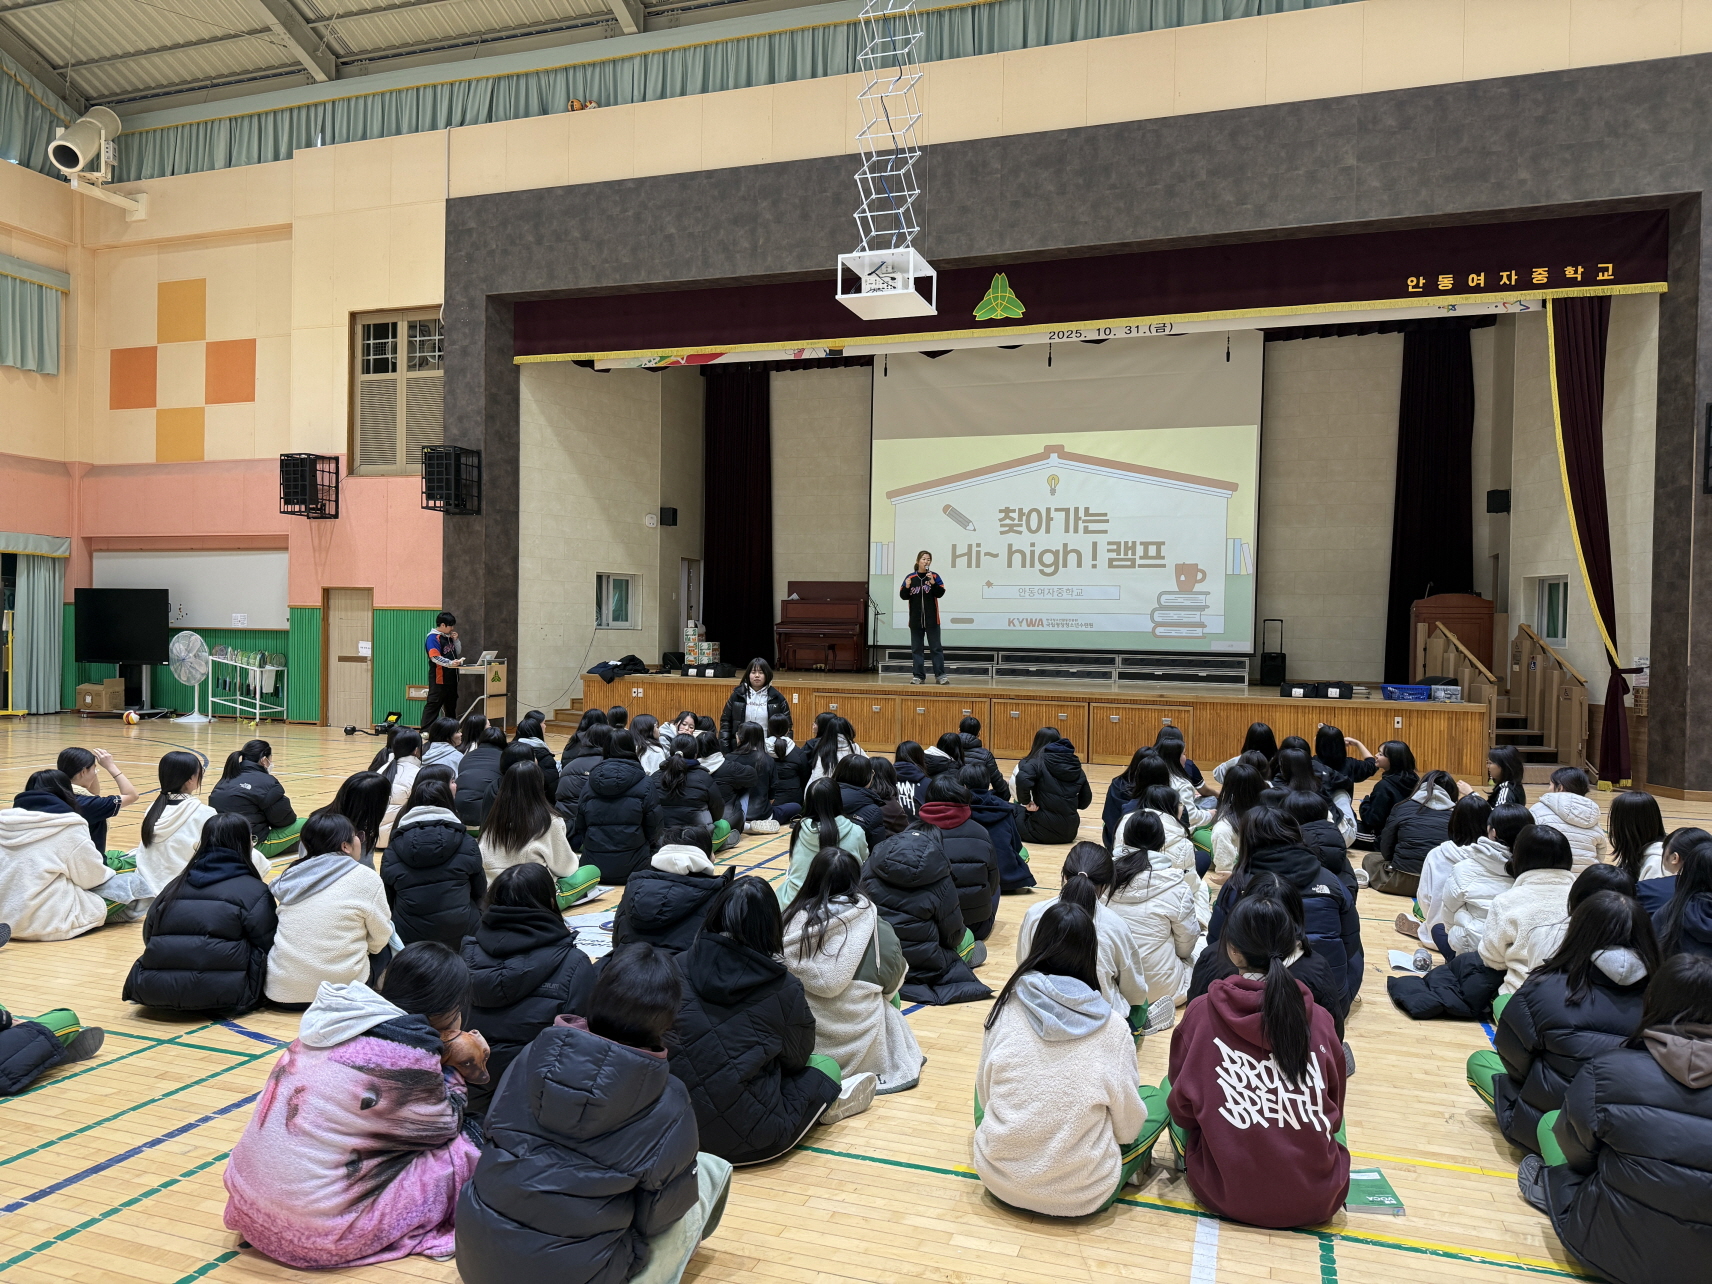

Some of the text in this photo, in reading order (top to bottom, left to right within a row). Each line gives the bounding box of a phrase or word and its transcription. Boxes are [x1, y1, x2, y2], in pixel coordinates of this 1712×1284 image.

[1407, 263, 1615, 292] 안동여자중학교
[1048, 330, 1088, 340] 2025.
[1096, 327, 1117, 337] 10.
[997, 506, 1110, 536] 찾아가는
[1106, 540, 1167, 569] 캠프
[1018, 587, 1084, 598] 안동여자중학교
[1007, 617, 1045, 628] KYWA
[1216, 1077, 1331, 1142] BREATH
